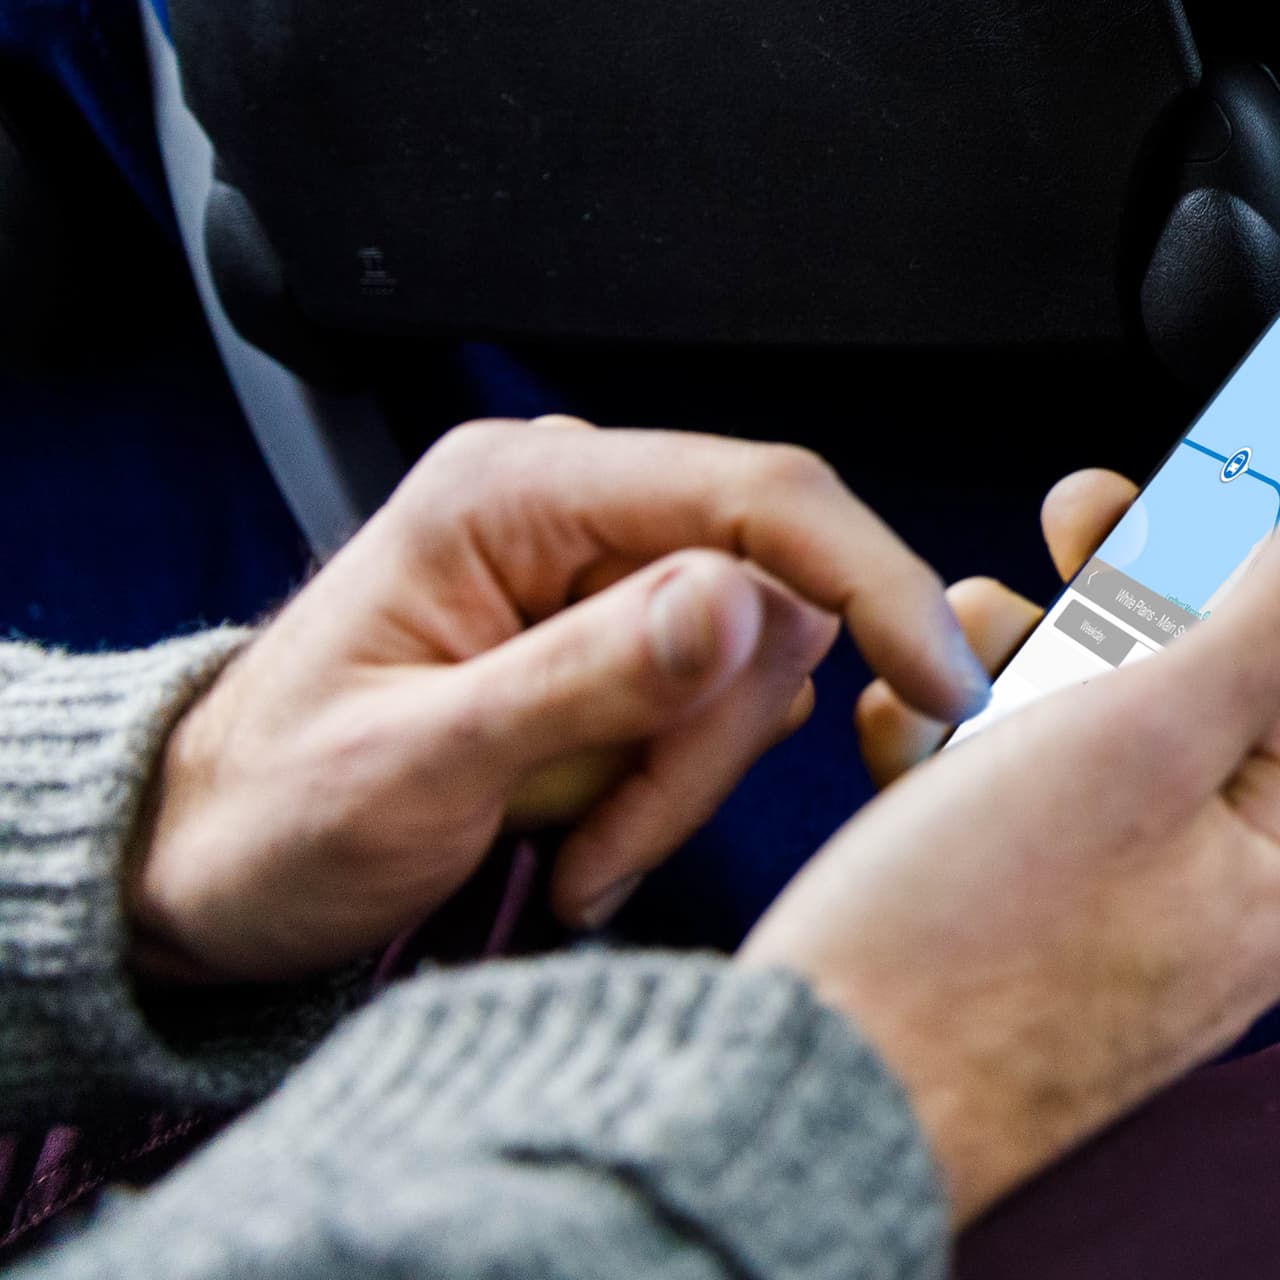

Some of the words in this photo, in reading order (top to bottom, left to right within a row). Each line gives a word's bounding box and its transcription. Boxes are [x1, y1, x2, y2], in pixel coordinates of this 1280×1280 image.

[1115, 587, 1135, 610] White
[1133, 599, 1155, 622] Plains
[1156, 613, 1177, 634] Main
[1079, 619, 1107, 645] Weekday
